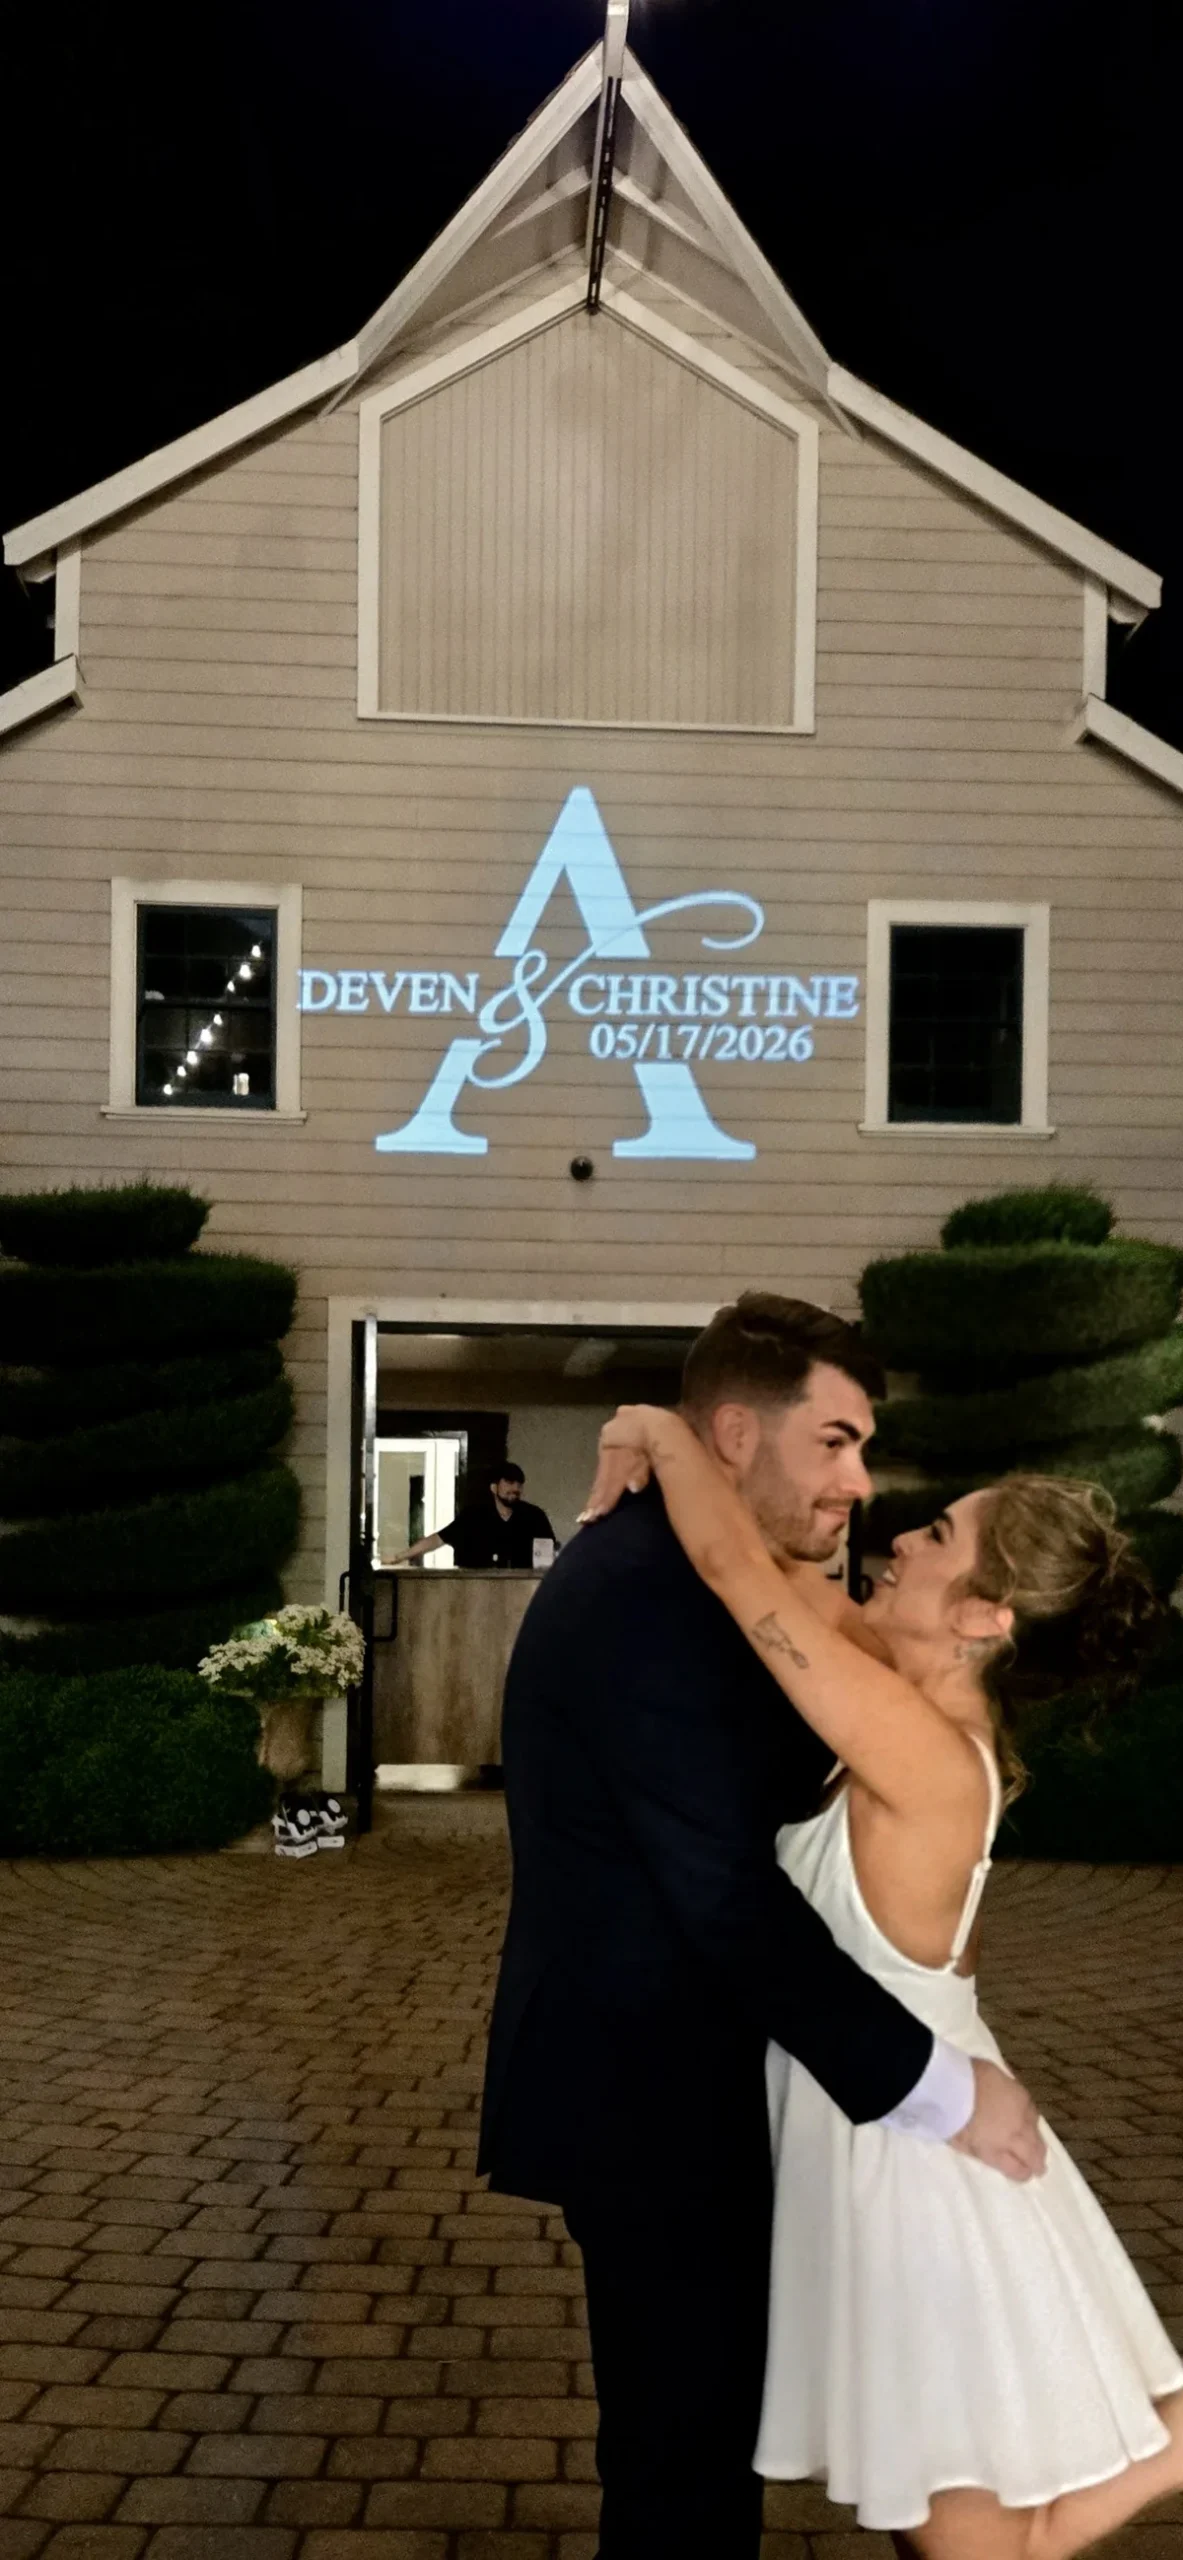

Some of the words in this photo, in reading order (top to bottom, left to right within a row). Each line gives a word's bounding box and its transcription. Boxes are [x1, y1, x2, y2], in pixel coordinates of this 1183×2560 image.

[296, 967, 480, 1014] DEVEN
[468, 890, 765, 1089] &
[568, 973, 860, 1018] CHRISTINE
[589, 1022, 815, 1062] 05/17/2026
